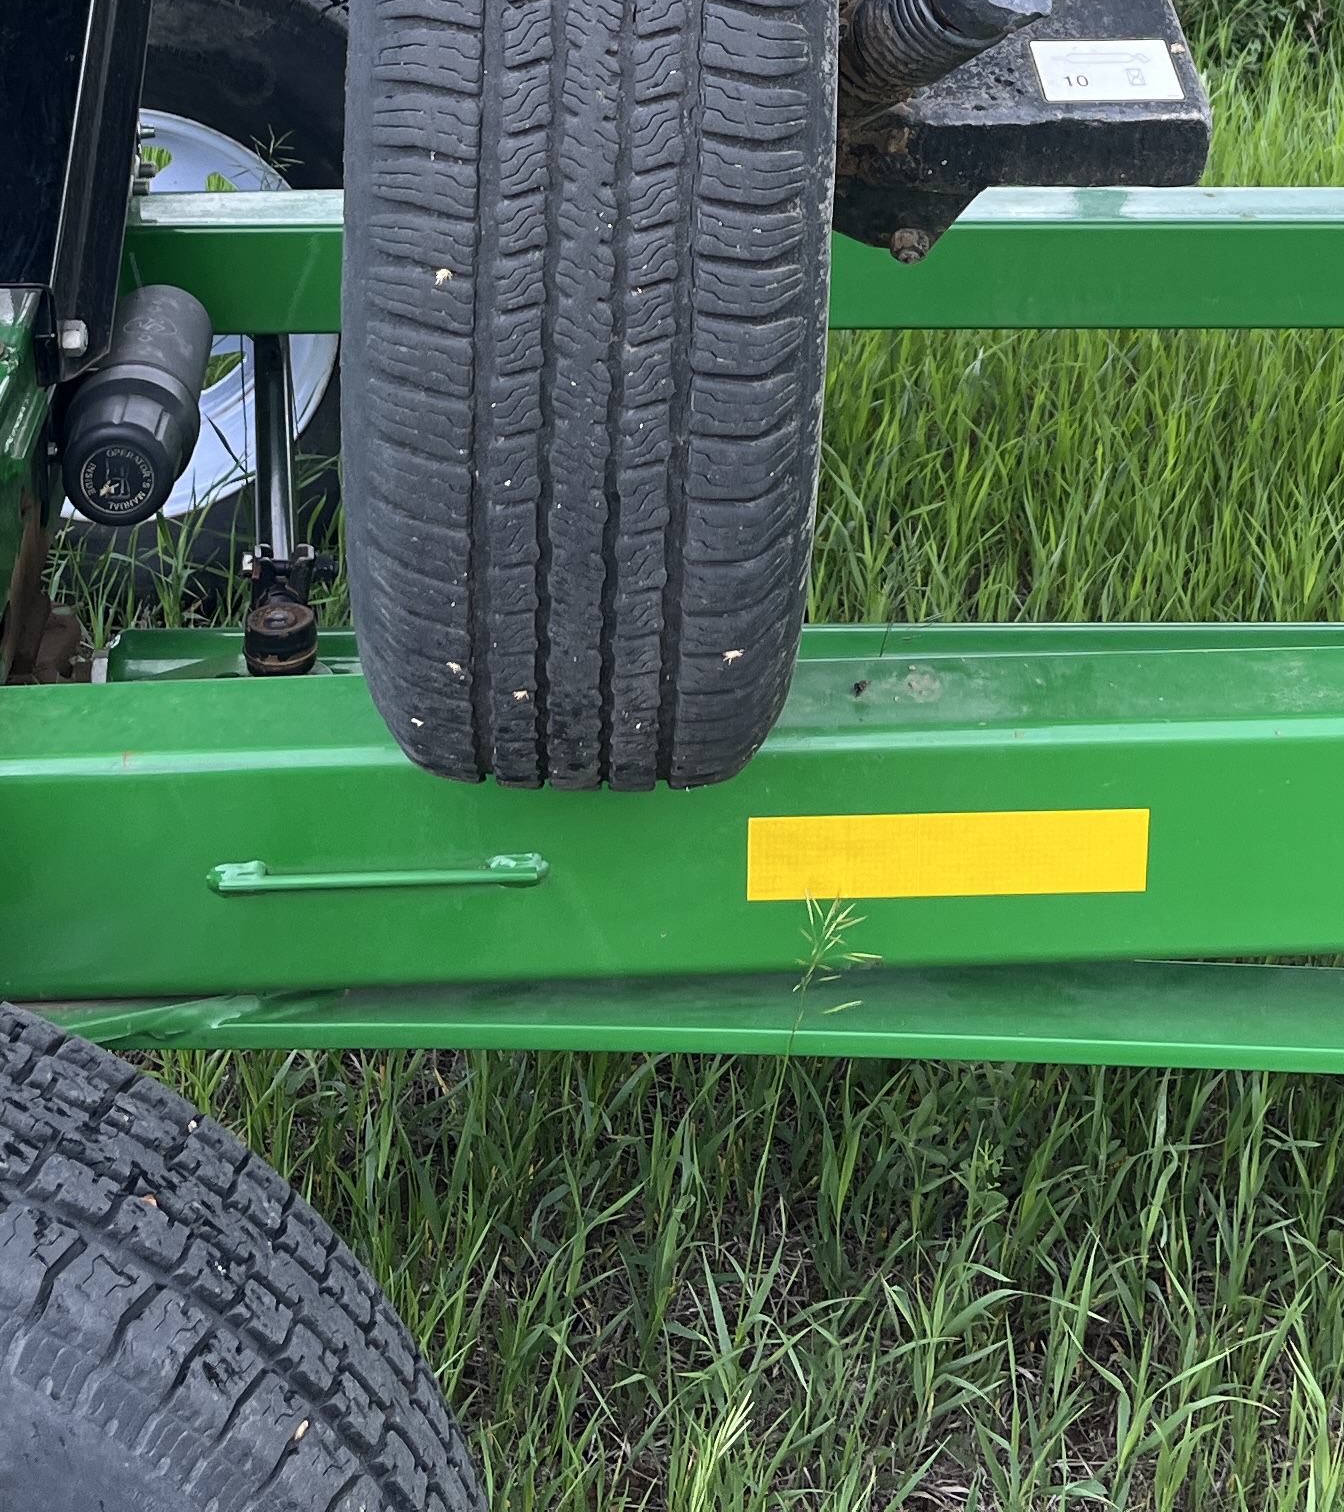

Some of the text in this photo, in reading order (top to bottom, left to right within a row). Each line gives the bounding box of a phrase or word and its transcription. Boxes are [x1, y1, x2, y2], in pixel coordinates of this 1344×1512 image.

[1064, 75, 1089, 87] 10
[84, 462, 97, 496] INSIDE
[106, 448, 153, 488] OPERATOR'S
[108, 491, 146, 511] MANUAL
